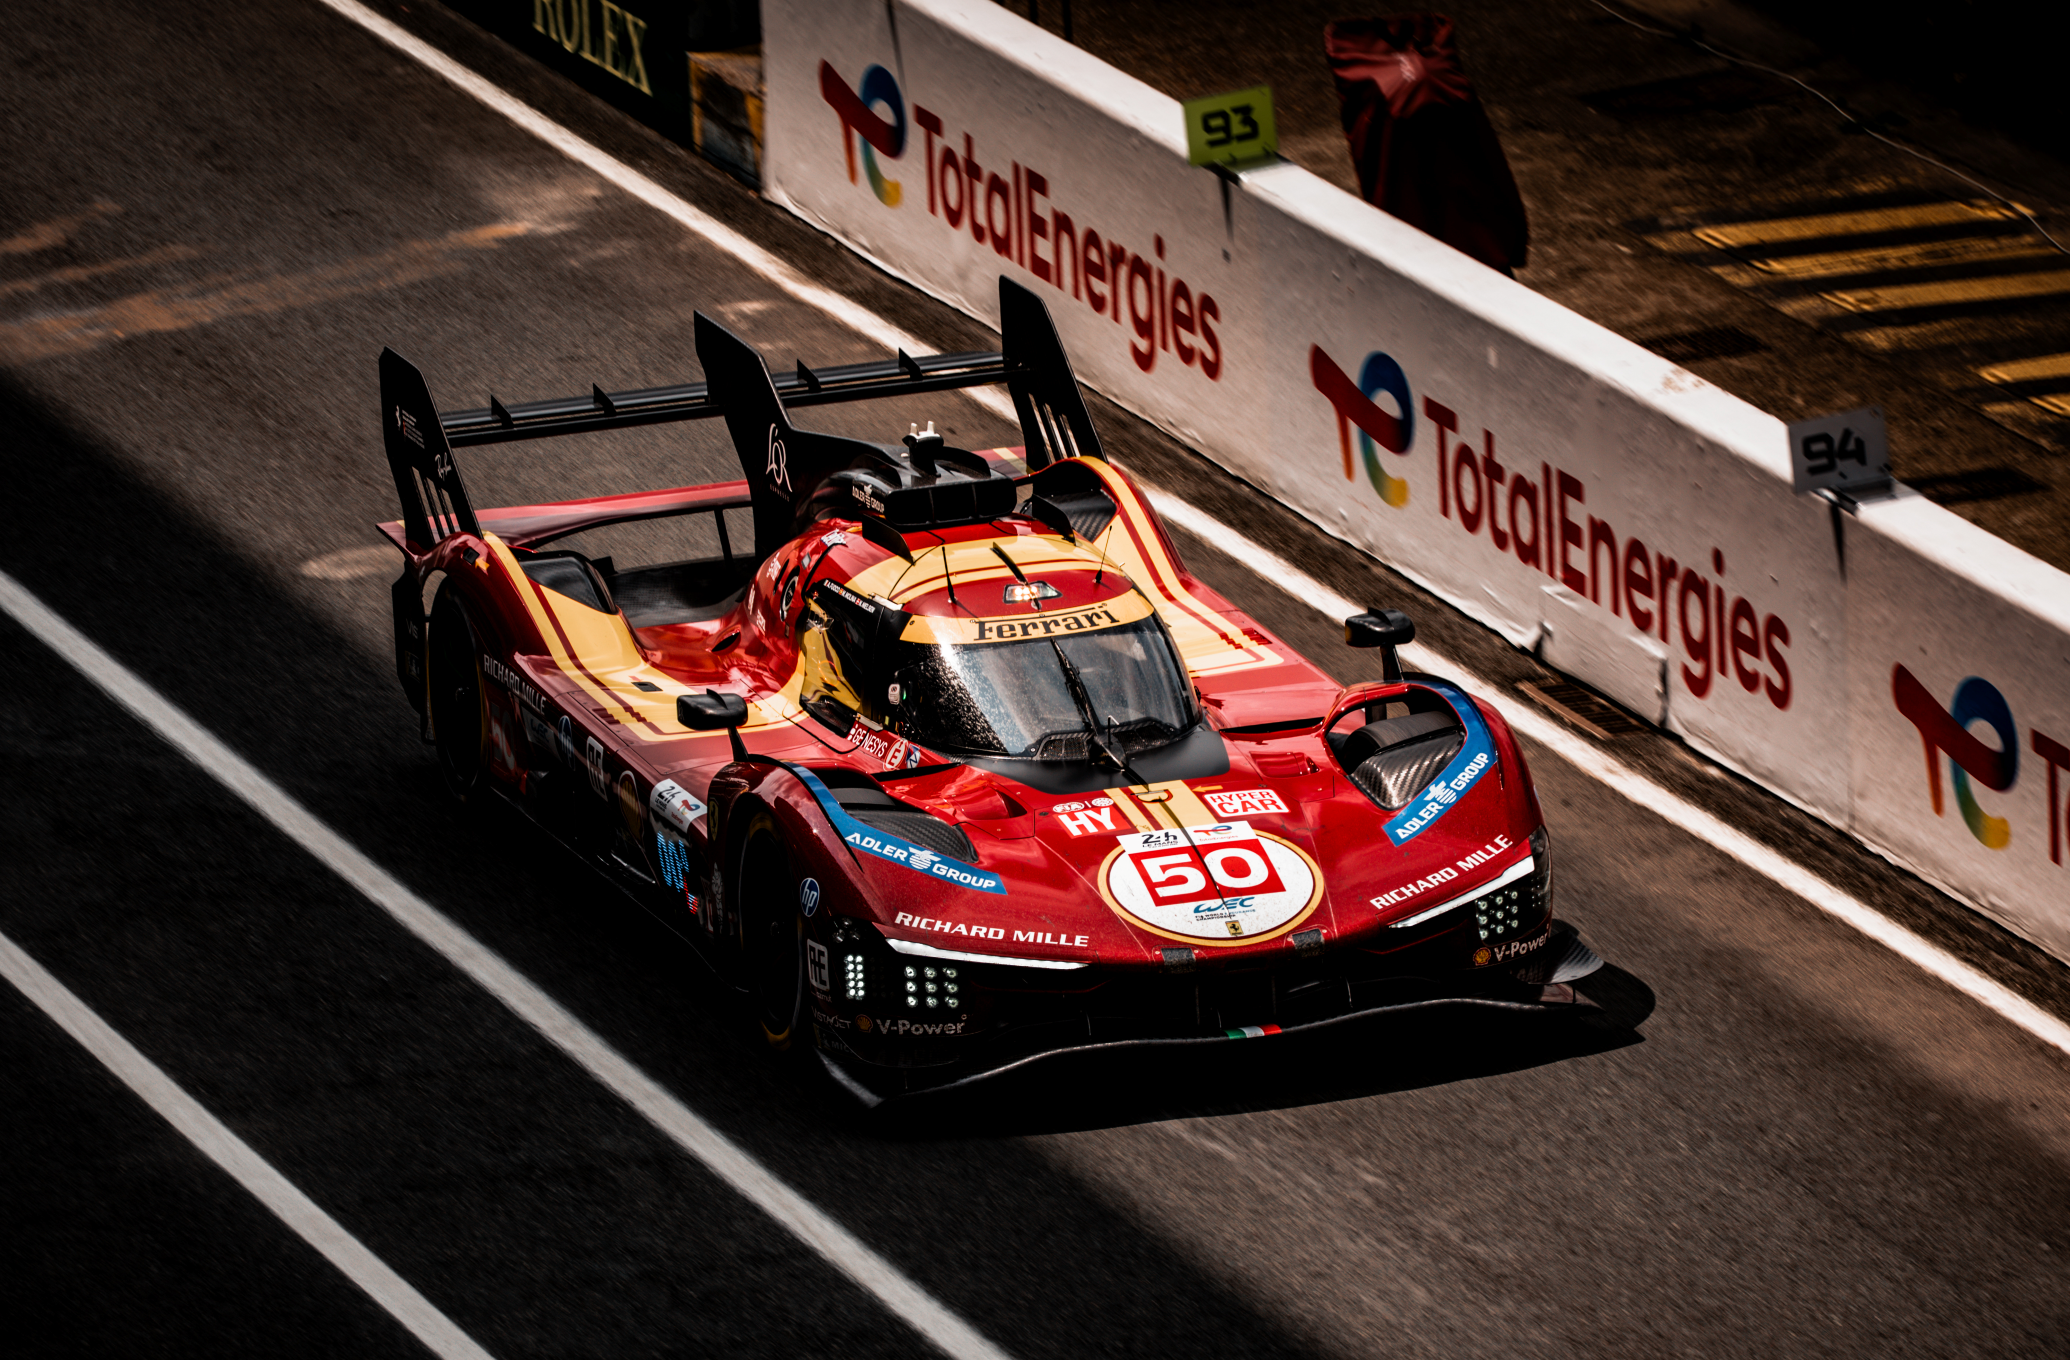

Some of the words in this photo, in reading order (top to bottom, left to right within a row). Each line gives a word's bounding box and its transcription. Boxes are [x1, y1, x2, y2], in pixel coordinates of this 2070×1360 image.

[1201, 103, 1259, 148] 93
[912, 102, 1222, 382] TotalEnergies
[1801, 427, 1868, 477] 94
[870, 496, 885, 514] GROUP
[1422, 394, 1793, 711] TotalEnergies
[973, 602, 1121, 642] Ferrari
[483, 652, 520, 695] RICHARD
[521, 680, 547, 716] MILLE
[852, 727, 888, 758] GENESYS
[1209, 791, 1274, 803] HYPER
[1217, 799, 1284, 814] CAR
[1395, 801, 1444, 840] ADLER
[1450, 752, 1489, 791] GROUP
[1057, 807, 1117, 837] HY
[845, 832, 908, 862] ADLER
[932, 863, 996, 889] GROUP
[1140, 852, 1269, 898] 50
[1369, 866, 1459, 910] RICHARD
[1456, 834, 1513, 872] MILLE
[801, 879, 819, 917] hp
[1193, 896, 1255, 914] WEC
[894, 911, 1005, 940] RICHARD
[1012, 930, 1090, 947] MILLE
[1493, 931, 1548, 962] V-Power
[875, 1018, 966, 1036] V-Power
